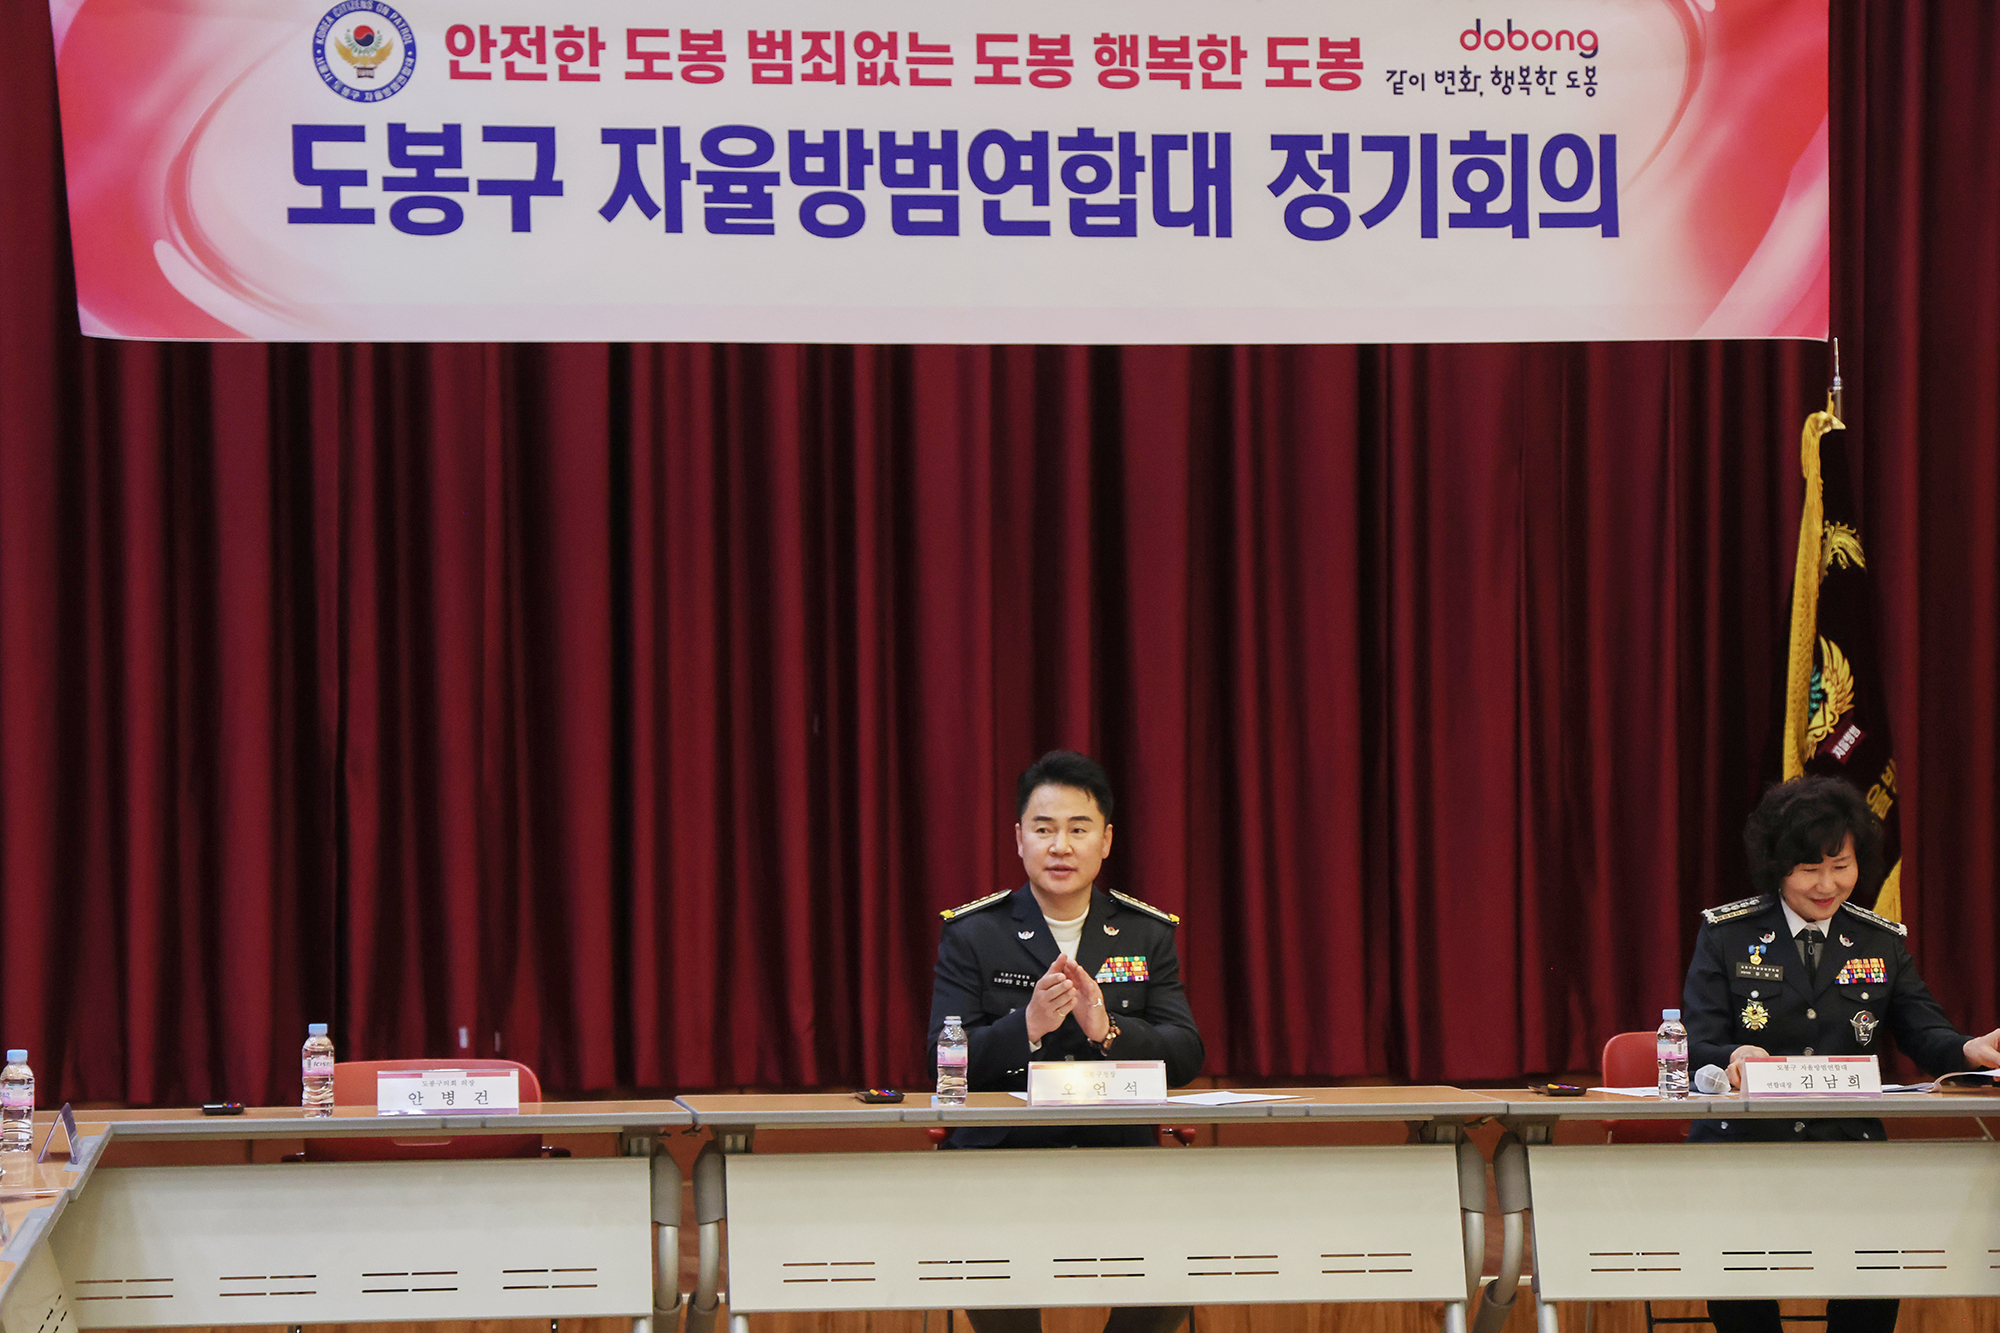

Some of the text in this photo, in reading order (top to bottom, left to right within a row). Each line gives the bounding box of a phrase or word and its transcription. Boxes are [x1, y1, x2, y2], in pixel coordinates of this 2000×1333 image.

[389, 11, 414, 45] PATROL
[1459, 19, 1599, 59] dobong
[445, 24, 1364, 92] 안전한 도봉 범죄없는 도봉 행복한 도봉
[1386, 65, 1598, 98] 같이 변화, 행복한 도봉
[287, 122, 1620, 242] 도봉구 자율방범연합대 정기회의
[421, 1079, 475, 1088] 도봉구의회 의장
[1776, 1063, 1848, 1072] 도봉구 자율방범연합대
